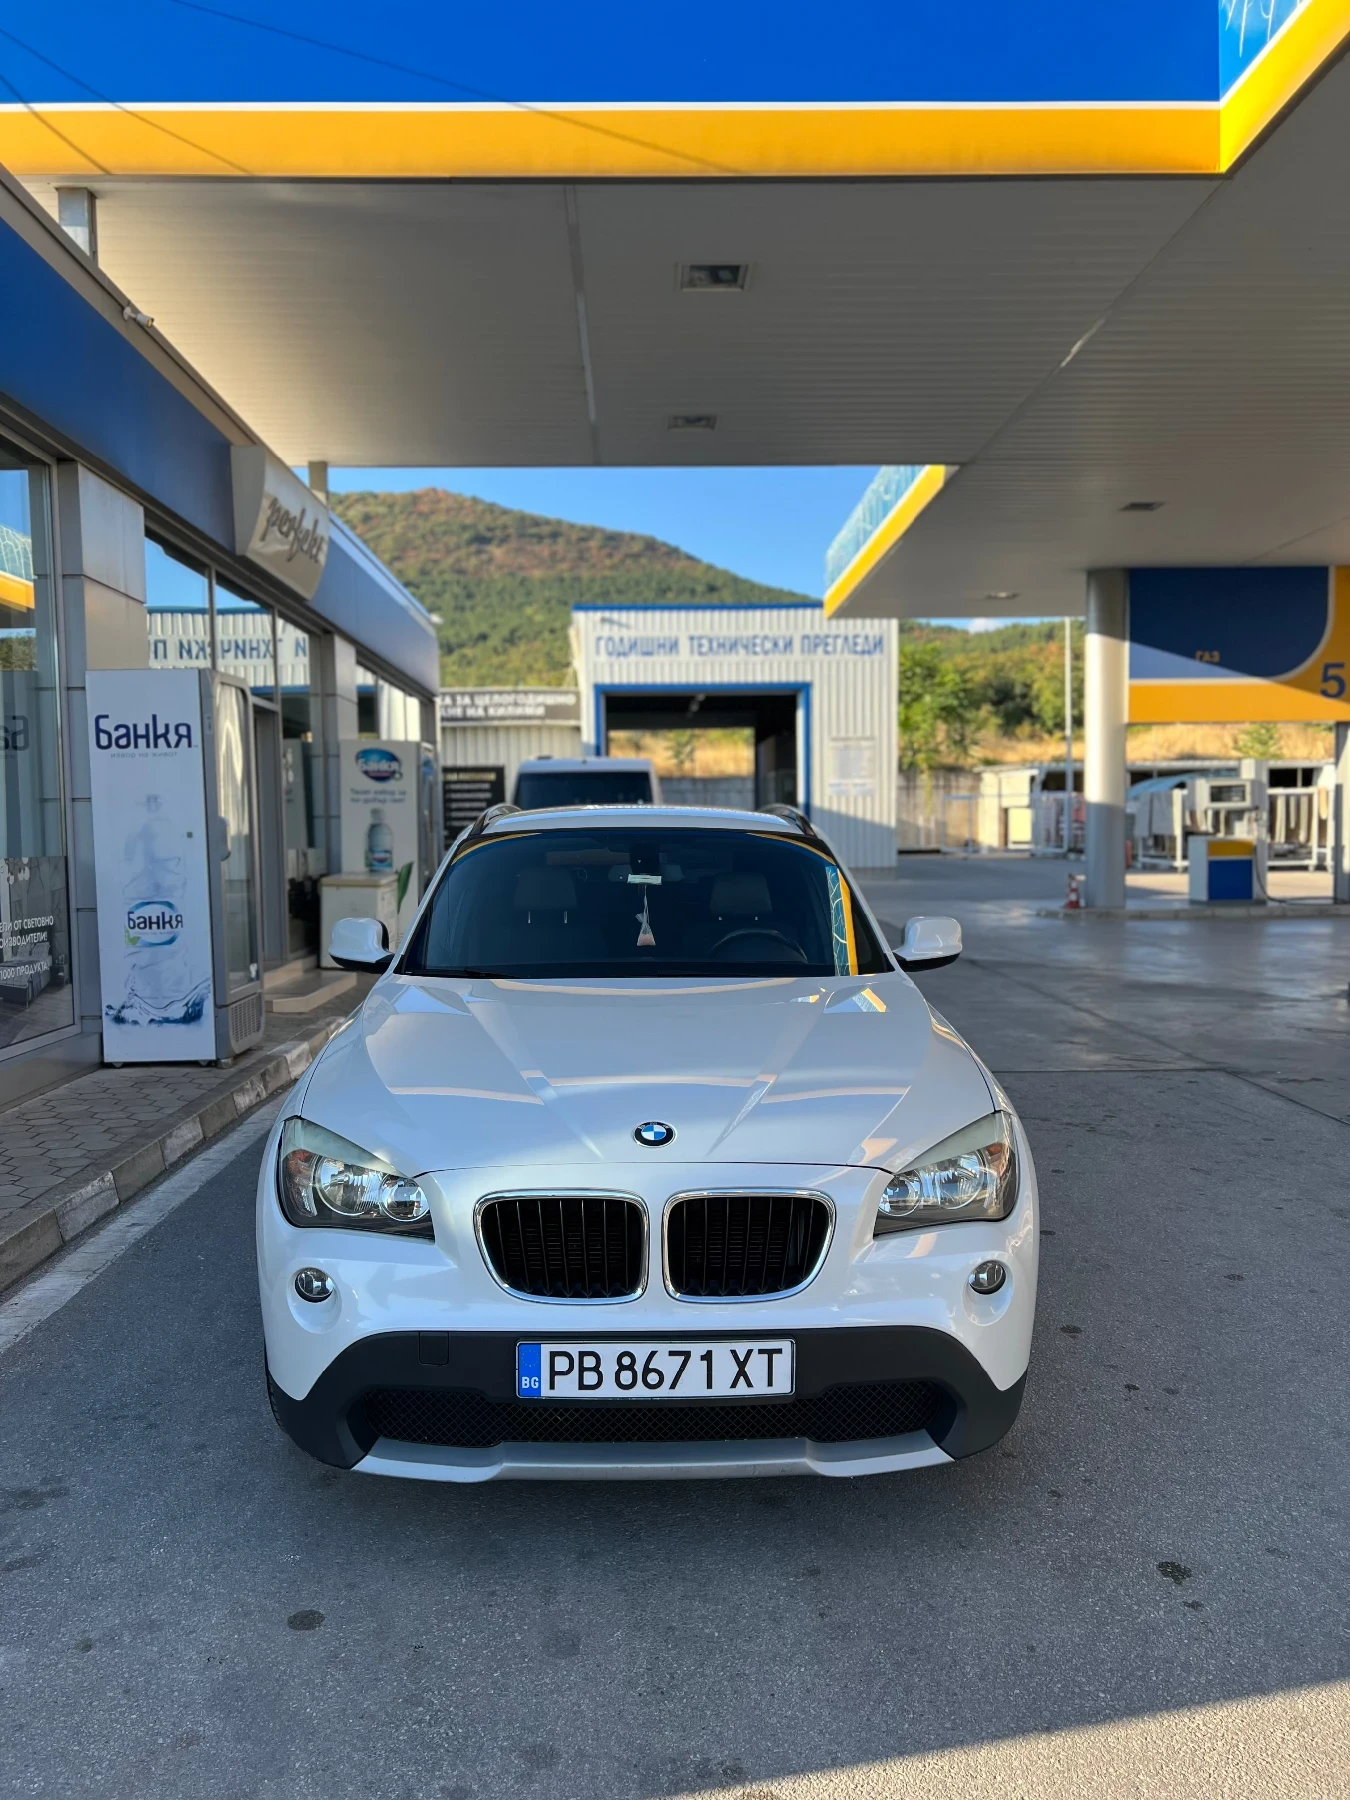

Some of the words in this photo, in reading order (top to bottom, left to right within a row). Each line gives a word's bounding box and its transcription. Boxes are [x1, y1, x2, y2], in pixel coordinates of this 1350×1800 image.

[596, 635, 679, 659] ГОДИШНИ
[688, 634, 794, 657] ТЕХНИЧЕСКИ
[801, 633, 884, 656] ПРЕГЛЕДИ
[1195, 650, 1221, 663] ГАЗ
[1320, 662, 1347, 699] 5
[14, 920, 22, 930] ОТ
[23, 915, 54, 929] СВЕТОВНО
[127, 911, 184, 931] Банкя
[549, 1350, 604, 1391] PB
[614, 1349, 713, 1390] 8671
[729, 1347, 783, 1390] XT
[521, 1376, 539, 1389] BG
